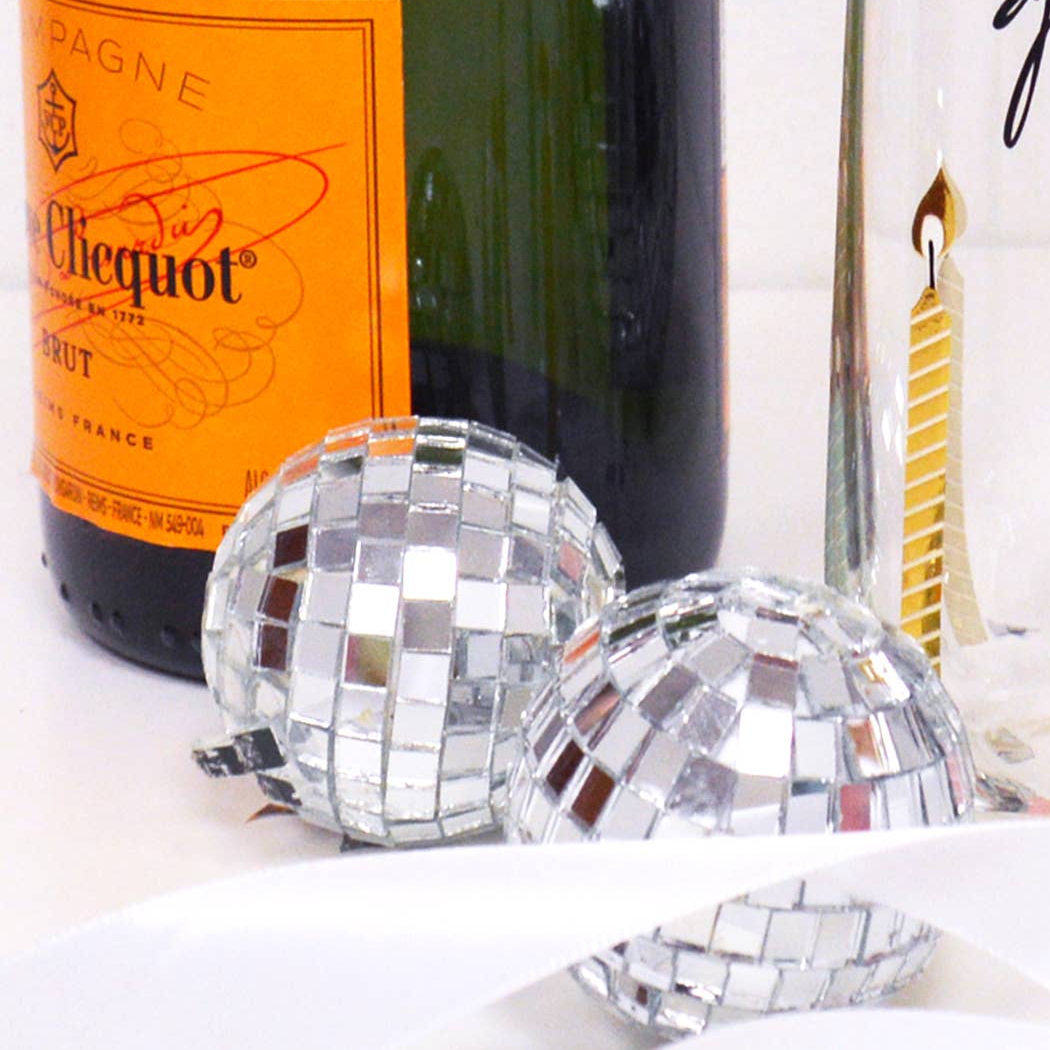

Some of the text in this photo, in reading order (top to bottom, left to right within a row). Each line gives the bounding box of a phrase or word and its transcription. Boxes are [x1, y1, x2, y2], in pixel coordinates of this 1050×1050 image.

[112, 309, 145, 326] 1772
[41, 326, 95, 380] BRUT
[72, 414, 154, 451] FRANCE
[111, 499, 143, 527] FRANCE
